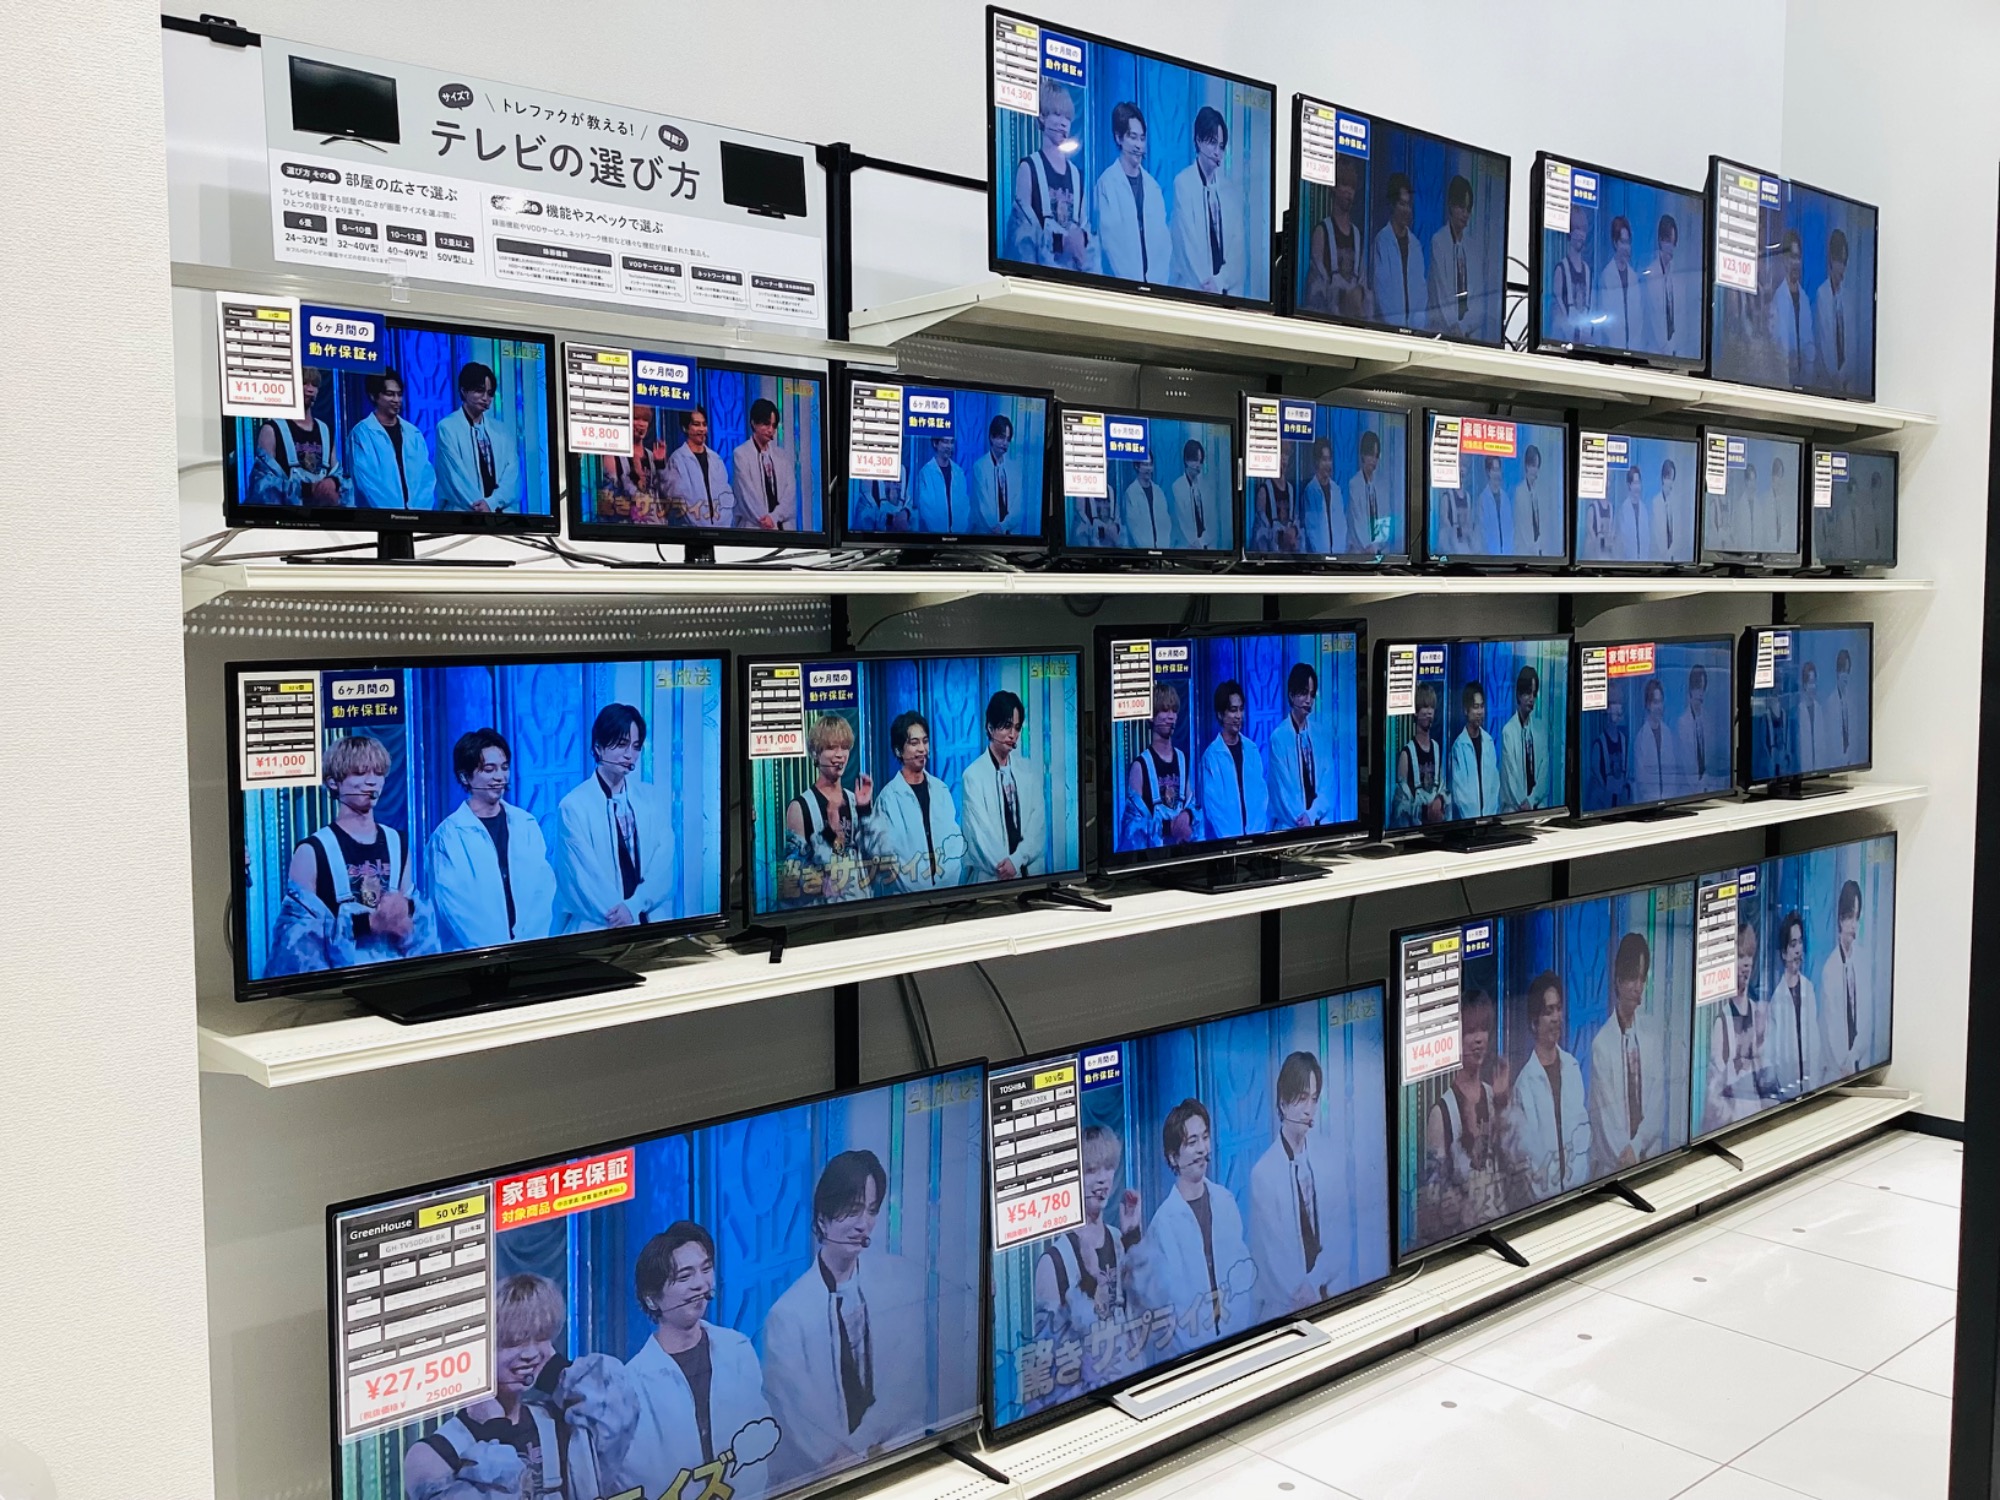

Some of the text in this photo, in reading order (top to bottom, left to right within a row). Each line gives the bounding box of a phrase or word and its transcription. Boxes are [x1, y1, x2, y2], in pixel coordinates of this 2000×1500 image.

[1001, 84, 1033, 101] ¥14,300
[503, 98, 635, 136] トレファクが教える!
[431, 119, 701, 200] テレビの選び方
[345, 171, 459, 202] 部屋の広さで選ぶ
[545, 203, 665, 234] 機能やスペックで選ぶ
[1722, 255, 1752, 276] ¥23,100
[315, 321, 369, 337] 6ヶ月間の
[308, 341, 378, 362] 動作保証付
[641, 365, 684, 379] 6ヶ月間の
[235, 380, 286, 395] ¥11,000
[636, 383, 691, 401] 動作保証付
[581, 426, 620, 440] ¥8,800
[857, 454, 893, 467] ¥14,300
[813, 673, 848, 684] 6ヶ月間の
[337, 682, 390, 696] 6ヶ月間の
[809, 689, 854, 702] 動作保証付
[331, 702, 398, 719] 動作保証付
[755, 733, 797, 745] ¥11,000
[255, 754, 306, 768] ¥11,000
[1412, 1036, 1453, 1060] ¥44,000
[999, 1081, 1027, 1094] TOSHIBA
[501, 1155, 628, 1207] 家電1年保証
[436, 1201, 469, 1220] 50 V型
[501, 1200, 551, 1225] 対象商品
[1007, 1189, 1071, 1224] ¥54,780
[349, 1217, 413, 1241] GreenHouse
[1016, 1280, 1231, 1404] 驚きサプライズ
[364, 1350, 472, 1401] ¥27,500
[426, 1382, 463, 1403] 25000
